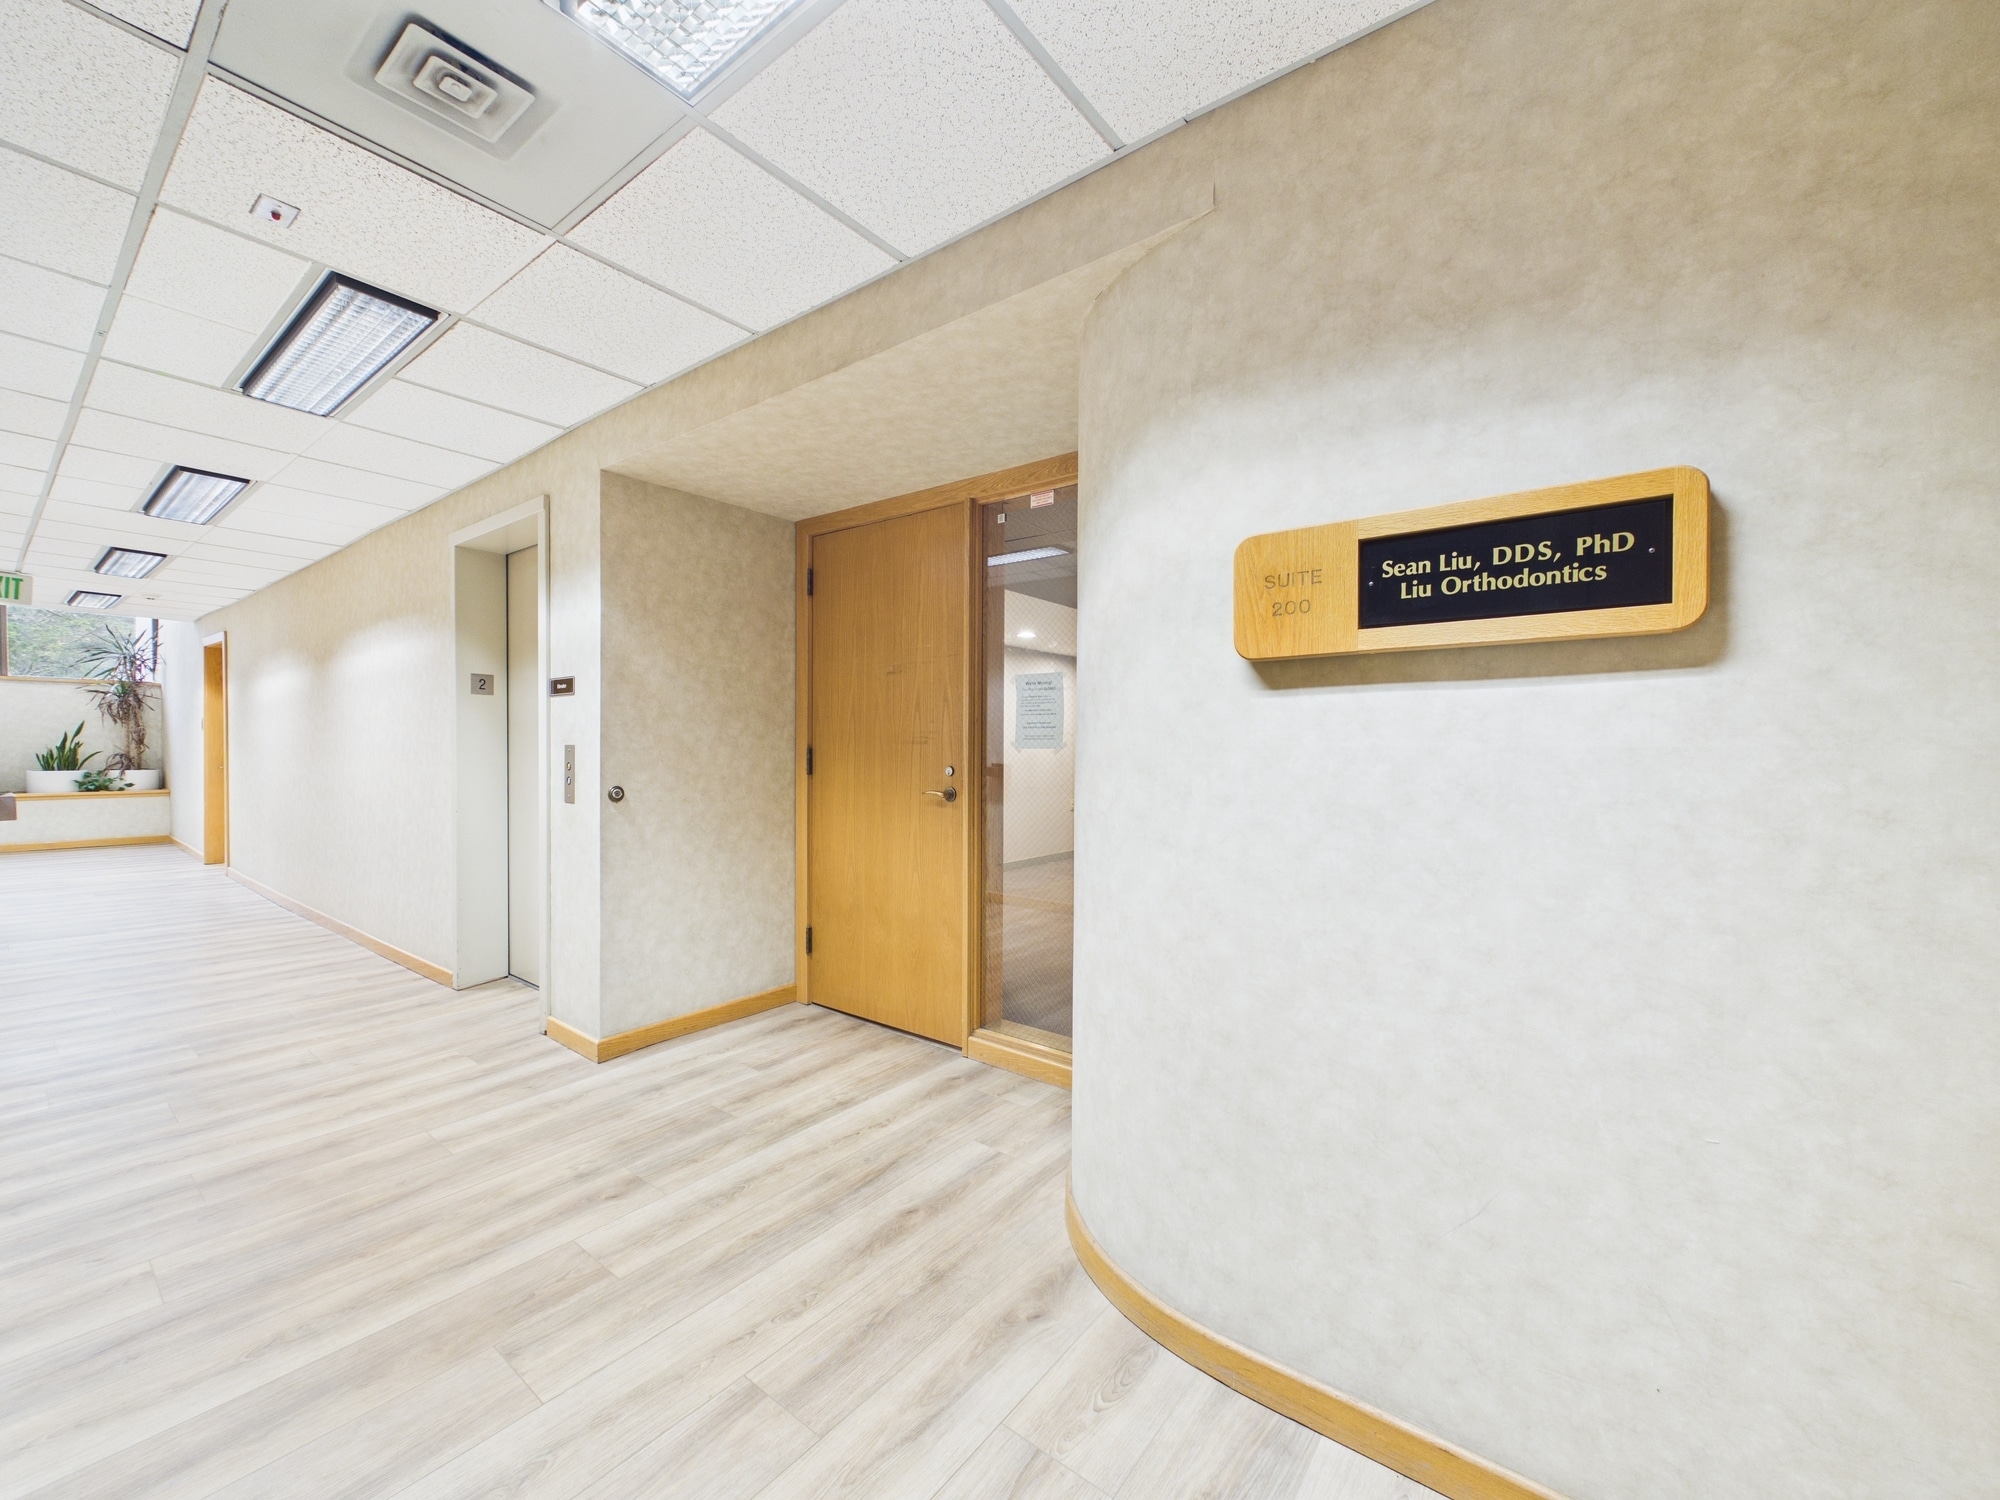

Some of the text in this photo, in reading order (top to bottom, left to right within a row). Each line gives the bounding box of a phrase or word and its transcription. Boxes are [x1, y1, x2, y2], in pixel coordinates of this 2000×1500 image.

[1382, 531, 1635, 578] Sean Liu, DDS, PhD
[0, 575, 24, 600] IT
[1264, 568, 1322, 589] SUITE
[1400, 562, 1607, 600] Liu Orthodontics
[1272, 599, 1311, 617] 200
[478, 678, 487, 690] 2
